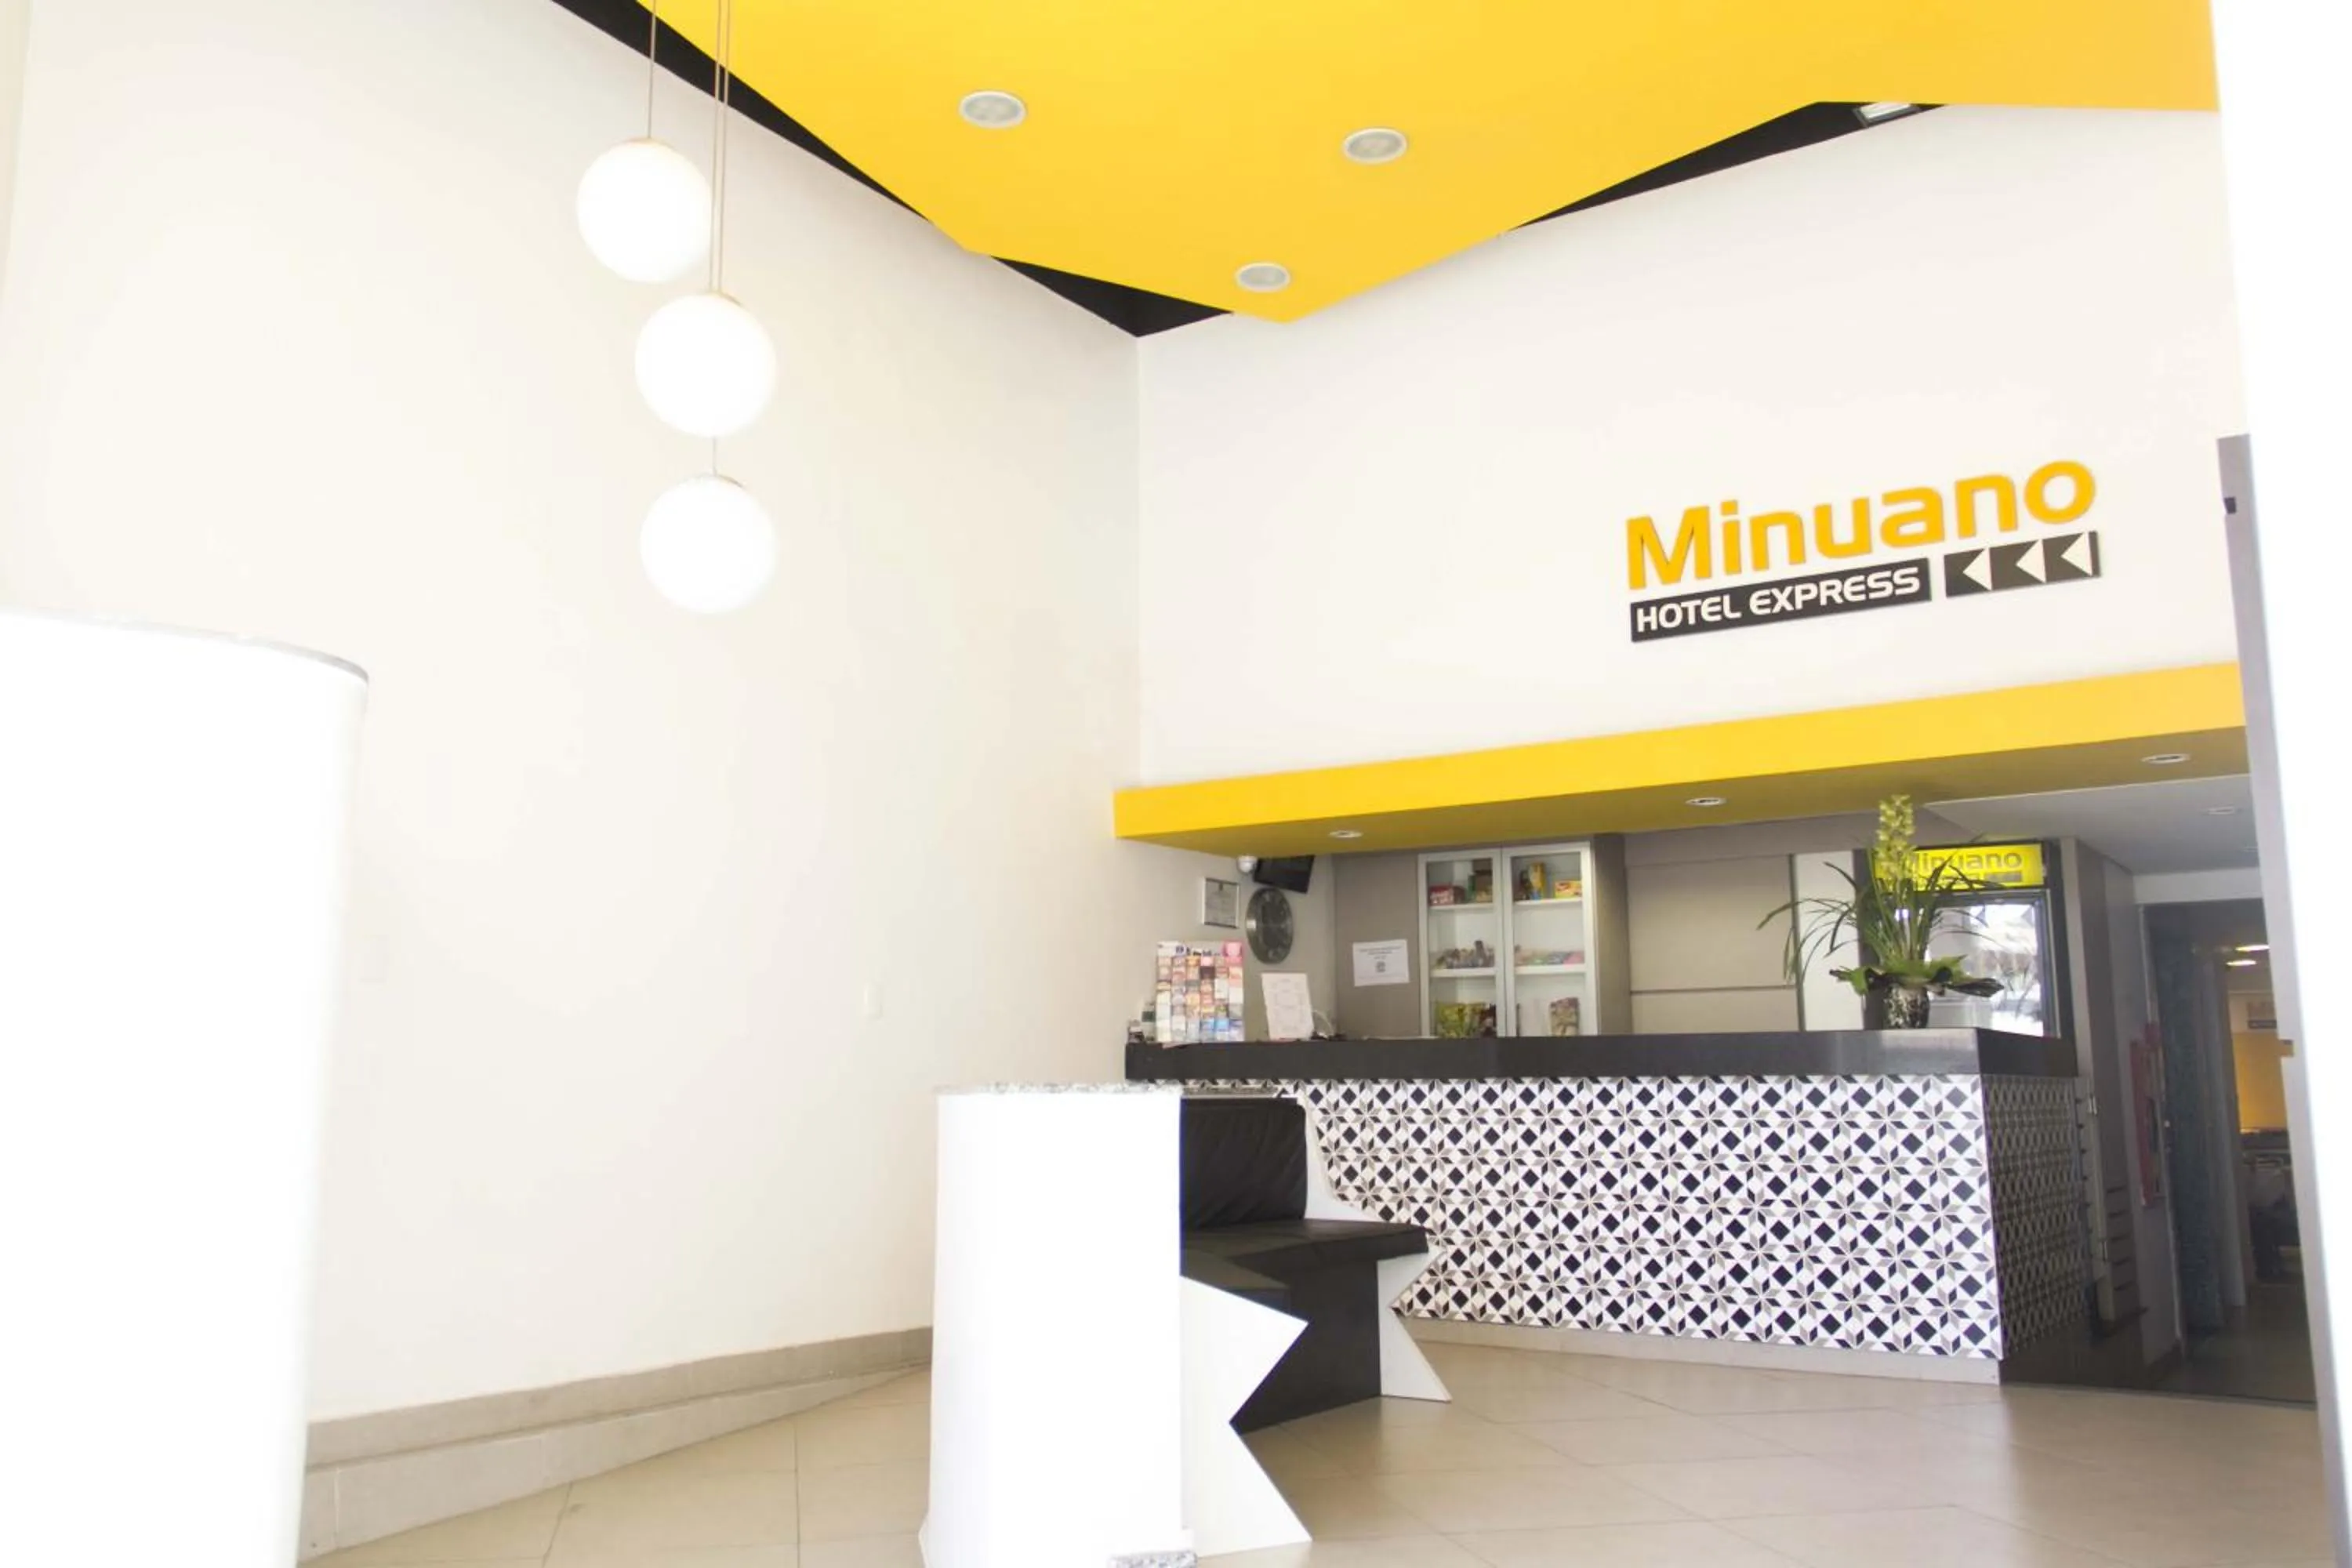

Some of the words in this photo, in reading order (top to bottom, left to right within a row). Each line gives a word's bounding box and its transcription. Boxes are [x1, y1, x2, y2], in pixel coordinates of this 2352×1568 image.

[1626, 460, 2096, 590] Minuano
[1636, 593, 1742, 633] HOTEL
[1749, 566, 1920, 615] EXPRESS
